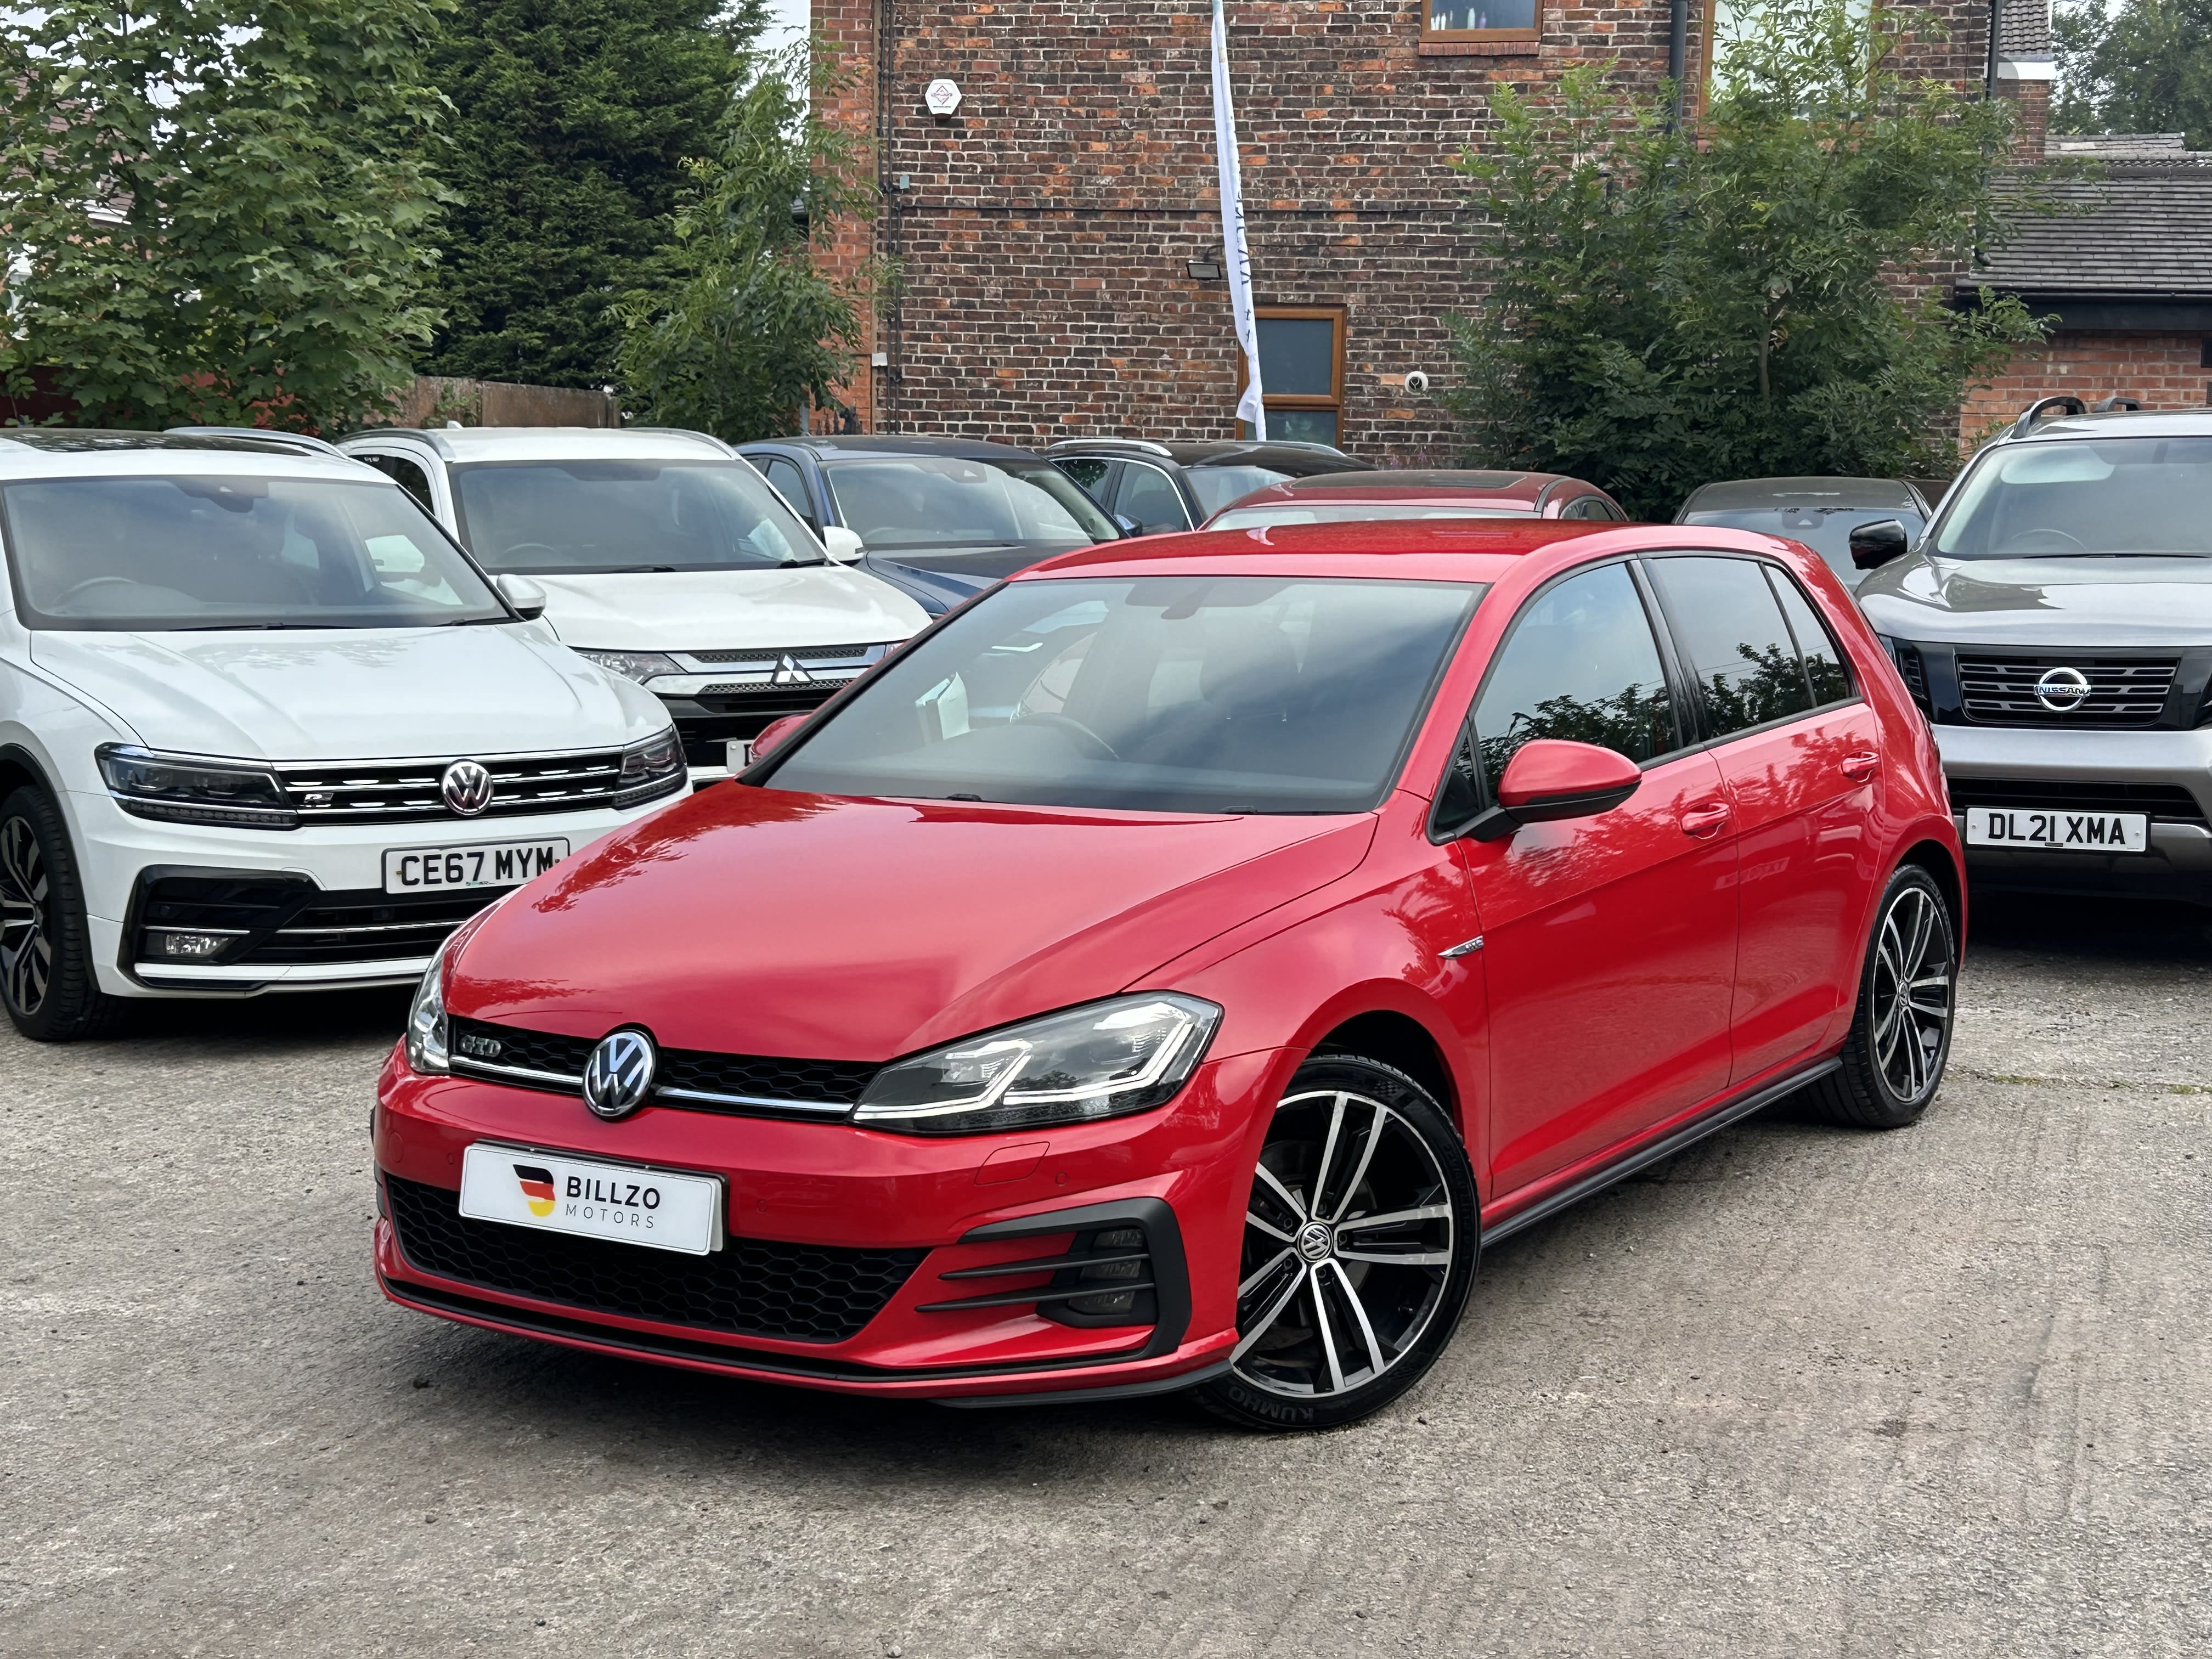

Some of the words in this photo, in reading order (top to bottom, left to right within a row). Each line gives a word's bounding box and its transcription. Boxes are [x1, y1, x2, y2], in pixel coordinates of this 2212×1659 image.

[2039, 686, 2085, 695] NISSAN
[1988, 812, 2056, 842] DL21
[2066, 816, 2126, 845] XMA
[400, 851, 485, 887] CE67
[495, 846, 554, 880] MYM
[566, 1175, 661, 1210] BILLZO
[565, 1203, 654, 1229] MOTORS
[1228, 1386, 1314, 1422] KUMHO
